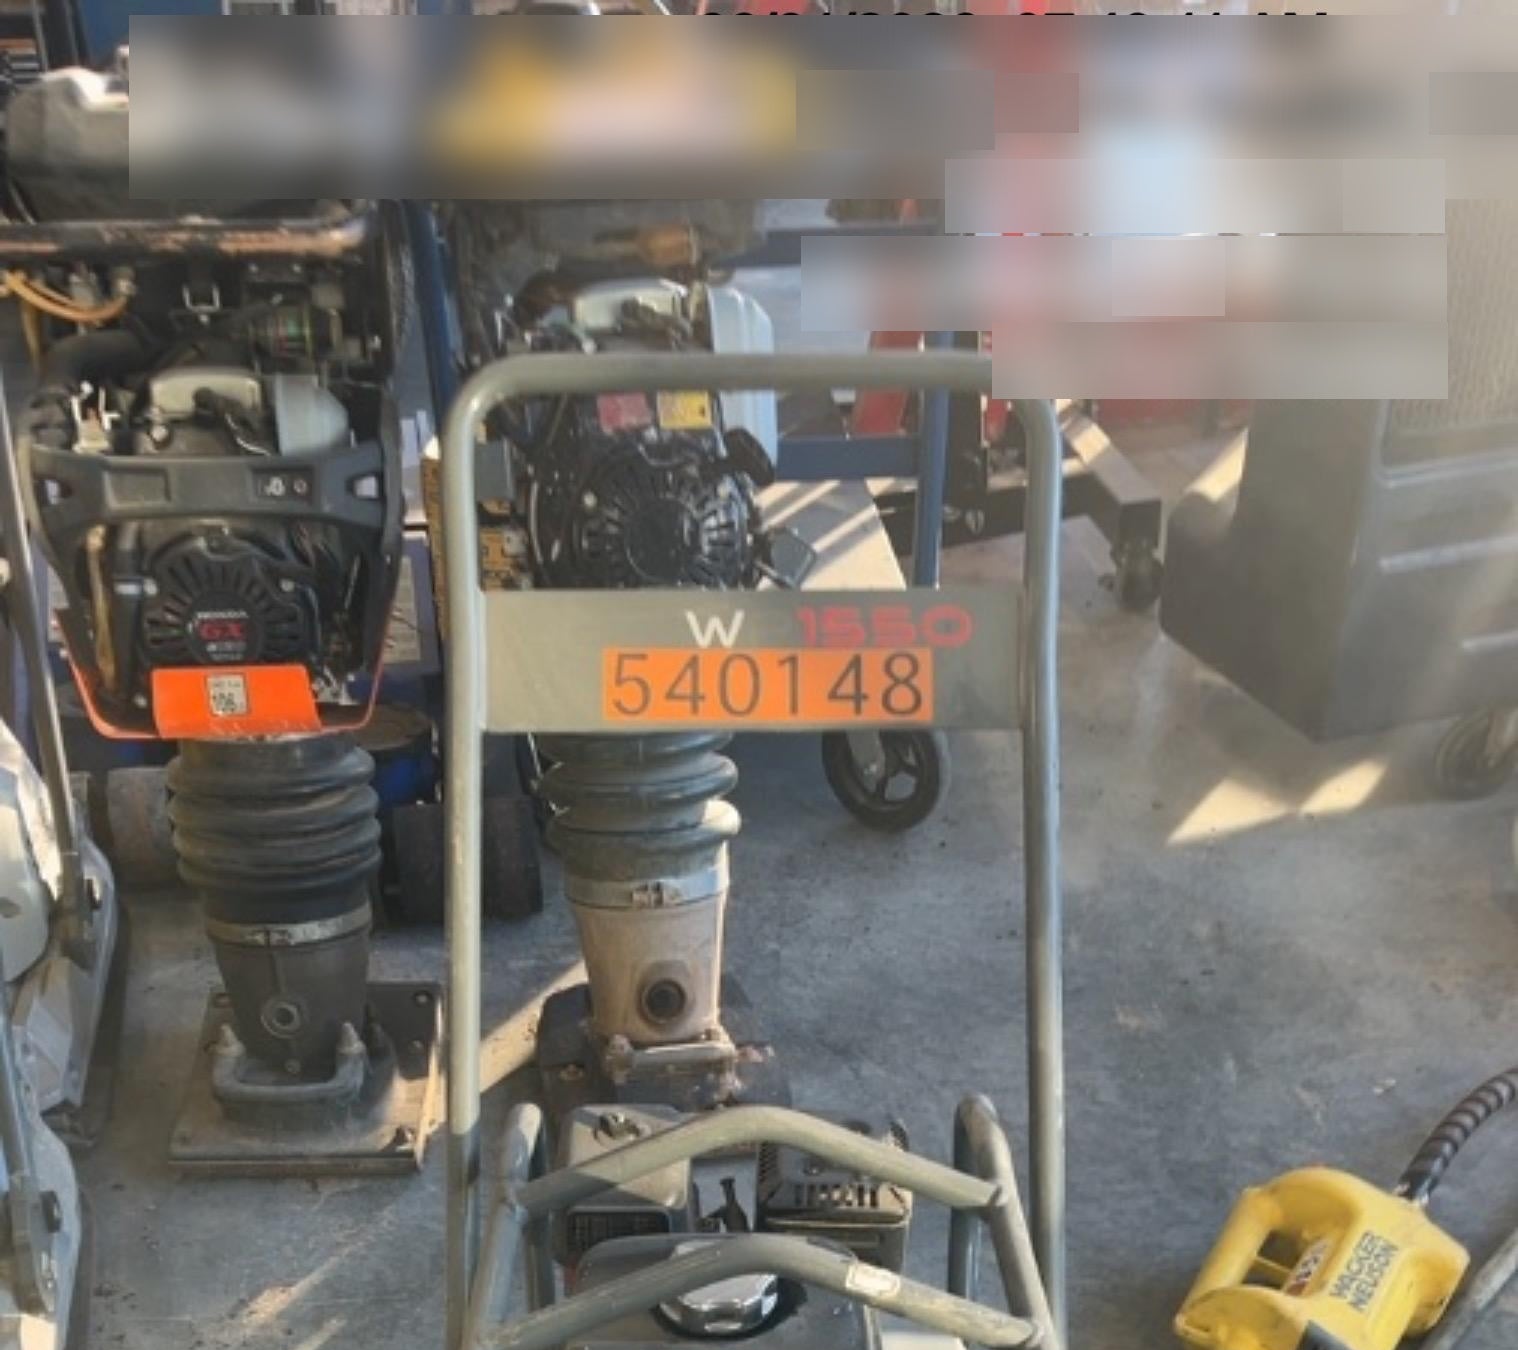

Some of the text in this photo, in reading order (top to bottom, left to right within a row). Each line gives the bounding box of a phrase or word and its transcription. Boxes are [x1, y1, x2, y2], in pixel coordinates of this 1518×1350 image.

[684, 604, 974, 648] W 1550
[611, 652, 924, 716] 540148
[1328, 1230, 1380, 1300] WACKER
[1347, 1238, 1399, 1313] NEUSON
